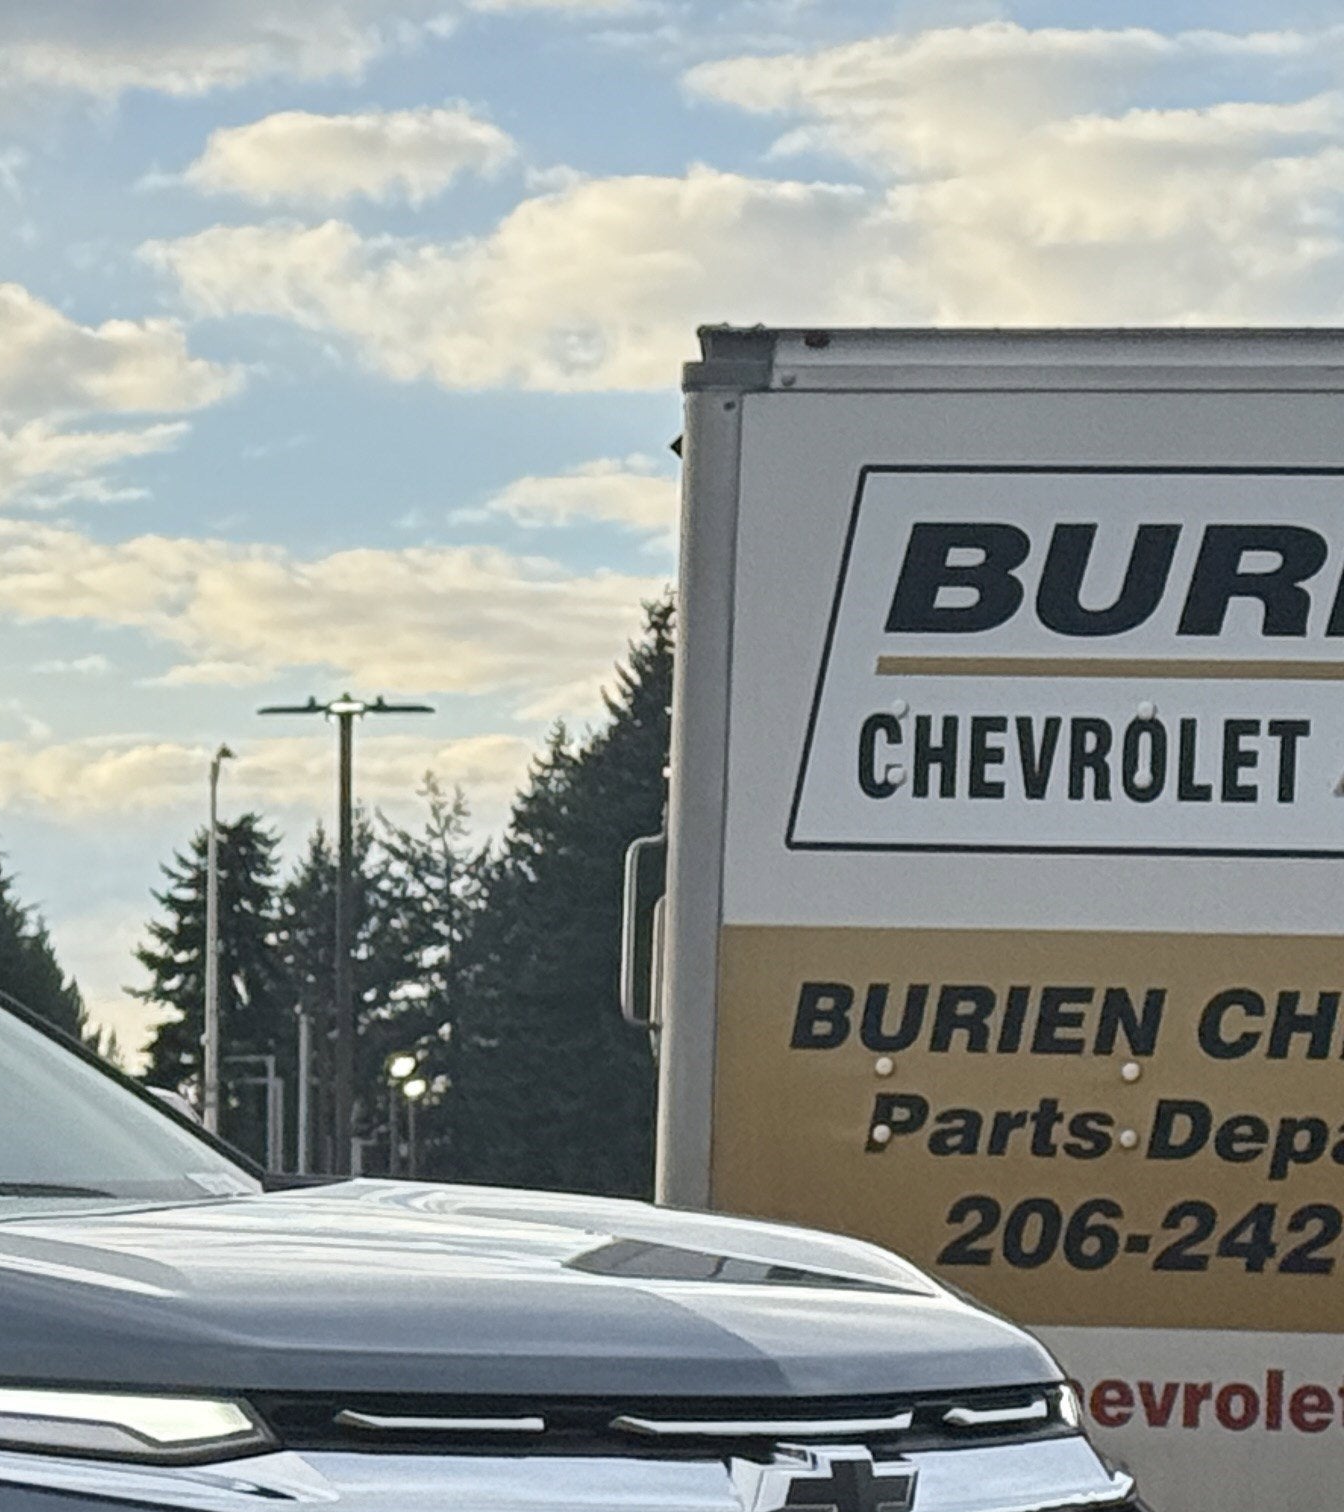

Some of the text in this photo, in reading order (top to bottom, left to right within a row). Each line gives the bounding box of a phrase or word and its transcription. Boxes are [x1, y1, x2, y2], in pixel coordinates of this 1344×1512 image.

[884, 522, 1344, 637] BUR
[857, 710, 1310, 803] CHEVROLET
[790, 981, 1344, 1060] BURIEN CH
[865, 1092, 1344, 1181] Parts Dep
[937, 1194, 1343, 1274] 206-242
[1070, 1369, 1344, 1434] evrole
